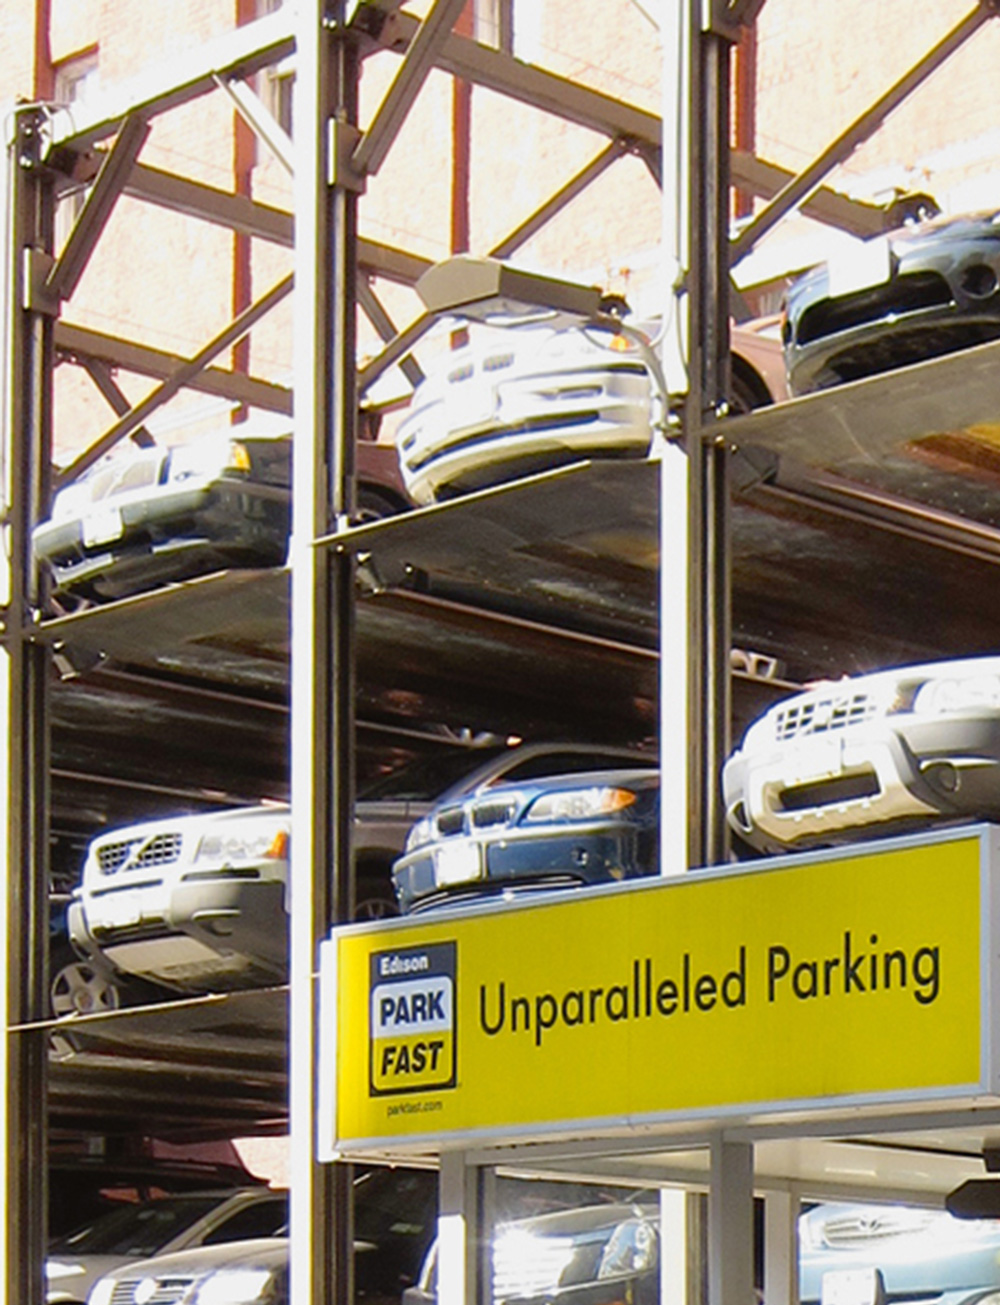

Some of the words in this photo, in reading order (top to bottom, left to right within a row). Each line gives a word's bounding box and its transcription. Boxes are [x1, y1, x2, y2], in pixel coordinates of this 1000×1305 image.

[380, 953, 428, 976] Edison
[480, 946, 747, 1045] Unparalleled
[769, 931, 941, 1005] Parking
[379, 990, 445, 1027] PARK
[381, 1042, 444, 1077] FAST
